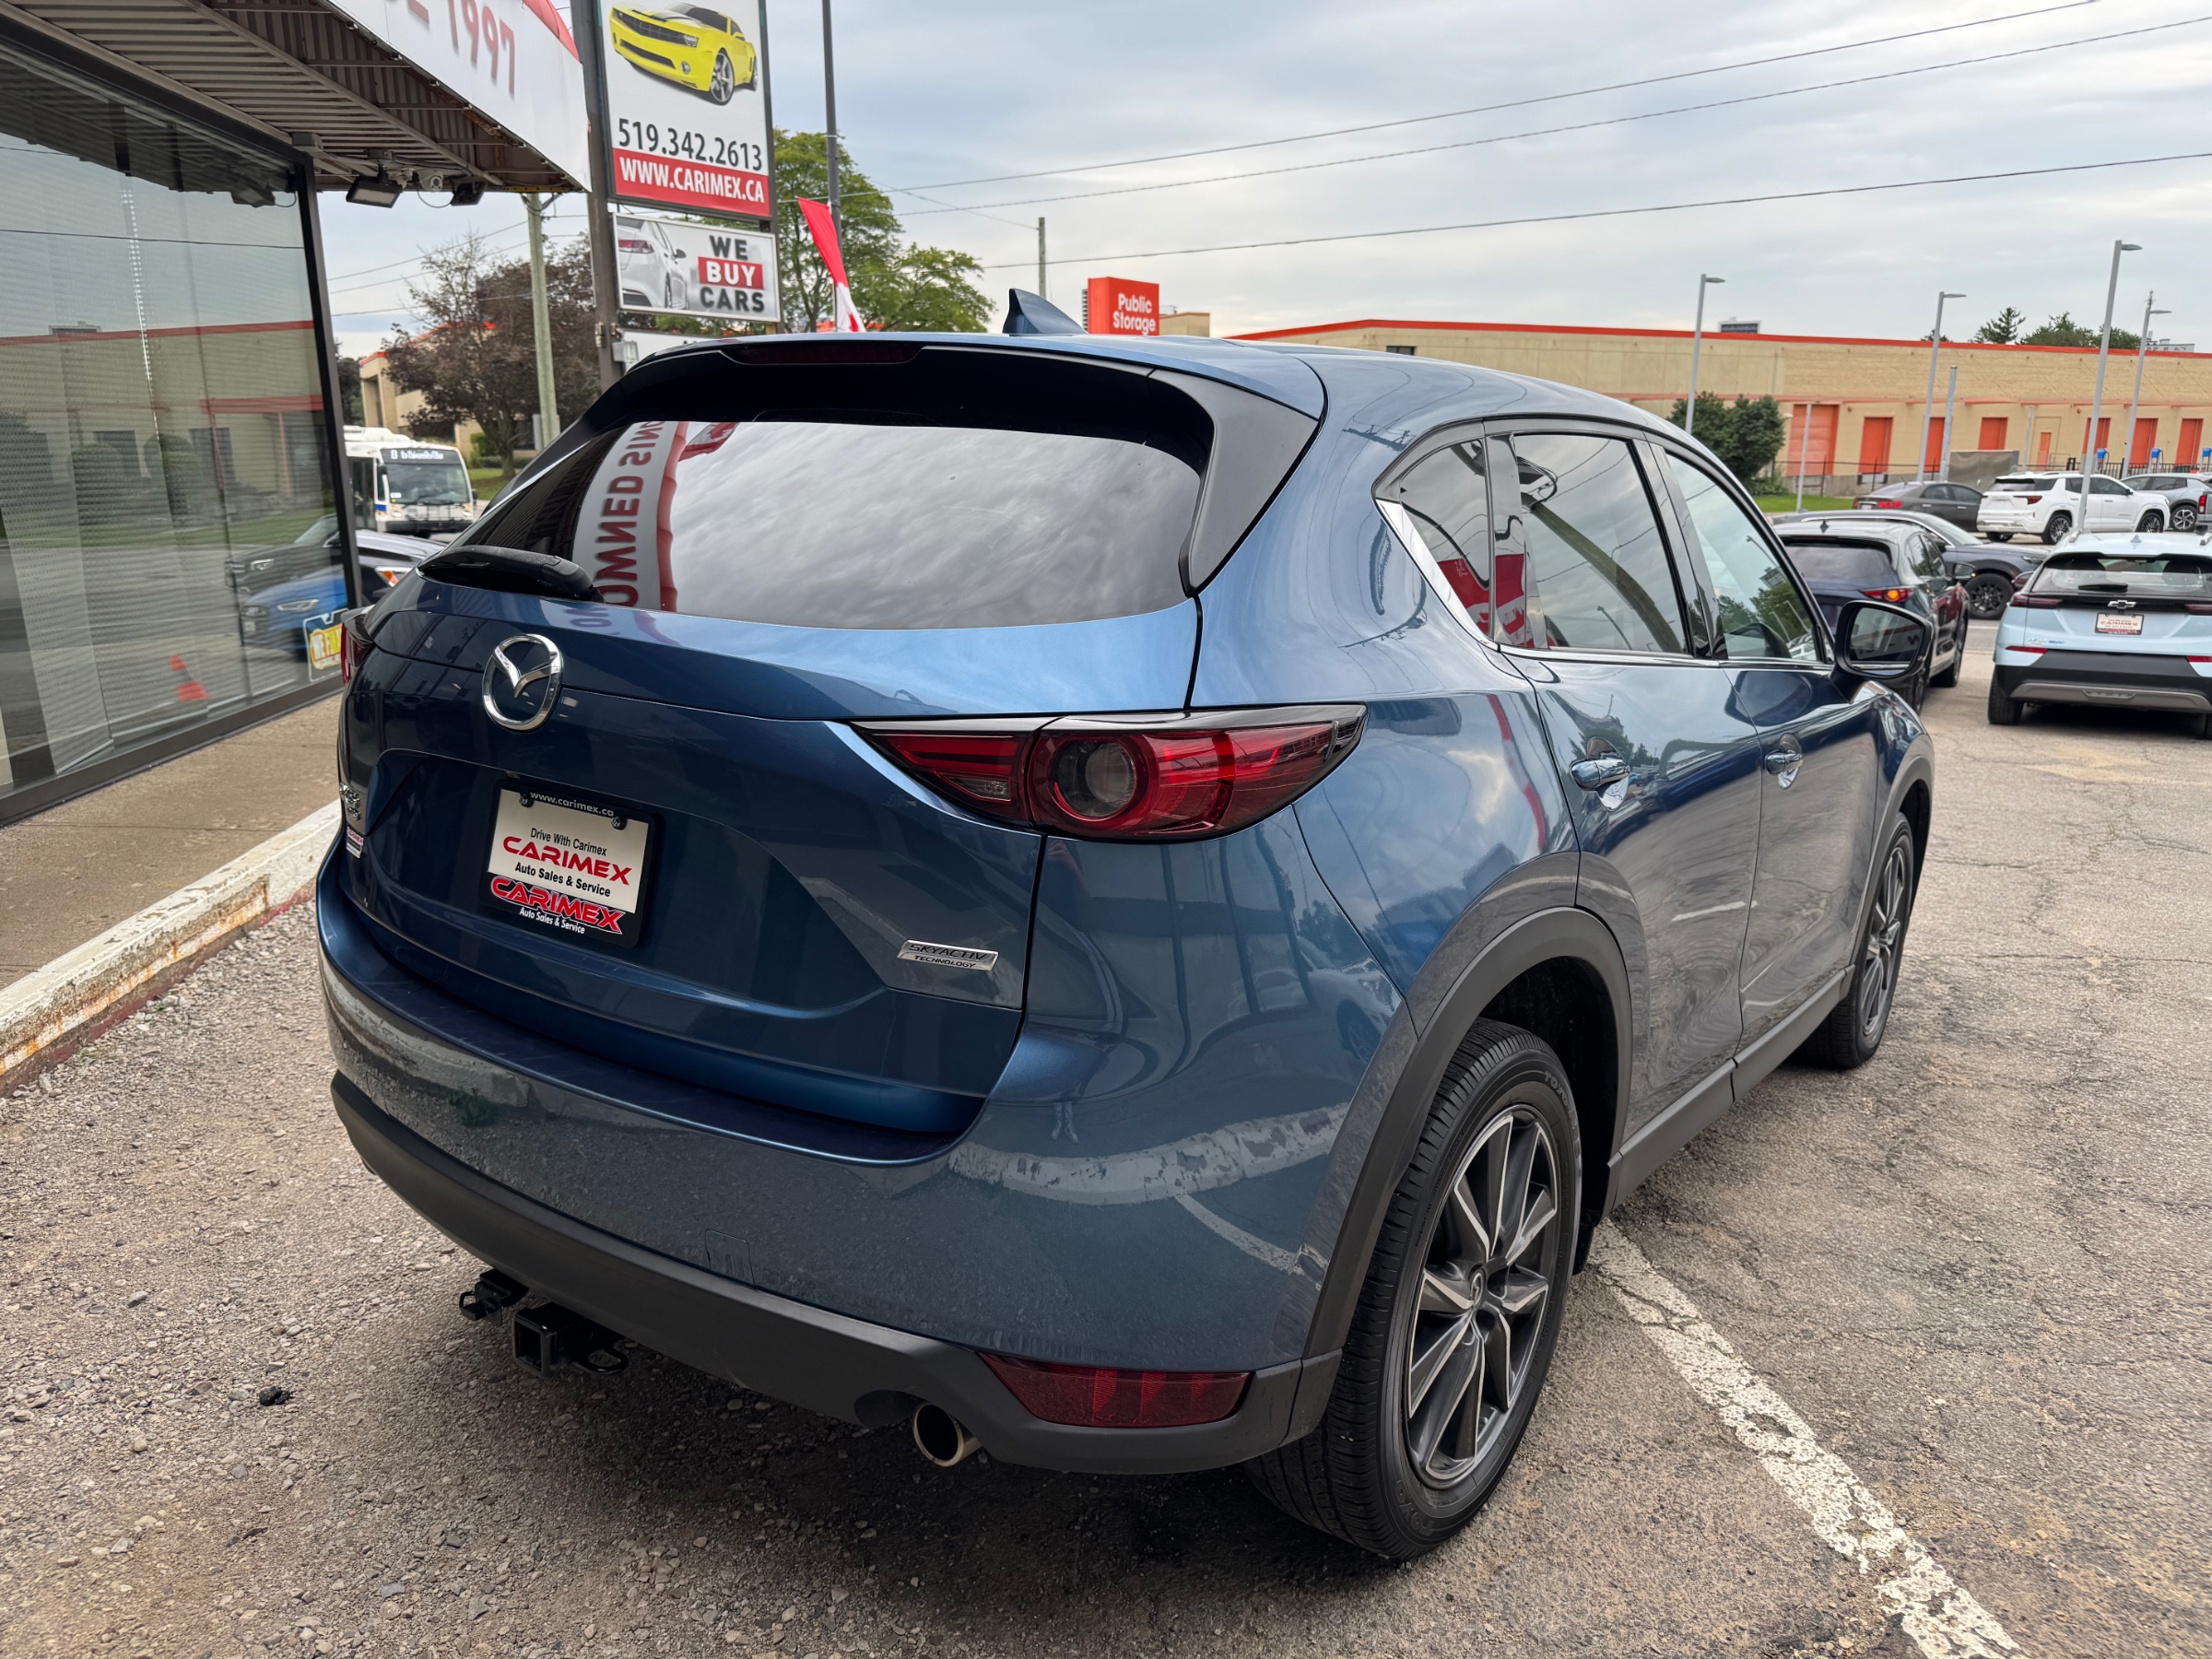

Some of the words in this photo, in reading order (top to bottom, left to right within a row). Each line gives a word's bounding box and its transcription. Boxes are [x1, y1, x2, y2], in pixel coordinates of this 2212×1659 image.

[448, 0, 516, 99] 1997
[618, 117, 763, 171] 519.342.2613
[618, 156, 765, 204] WWW.CARIMEX.CA
[709, 235, 748, 261] WE
[705, 260, 756, 287] BUY
[700, 286, 765, 312] CARS
[1117, 292, 1153, 314] Public
[1112, 311, 1157, 336] Storage
[530, 791, 615, 817] www.carimex.ca
[530, 827, 552, 842] Drive
[553, 832, 571, 848] With
[572, 838, 607, 857] Carimex
[502, 835, 632, 887] CARIMEX
[514, 861, 536, 877] Auto
[538, 867, 564, 885] Sales
[565, 876, 573, 887] &
[575, 877, 611, 898] Service
[490, 876, 627, 935] CARIMEX
[519, 906, 535, 920] Auto
[535, 912, 554, 925] Sales
[554, 917, 559, 926] &
[560, 919, 586, 935] Service
[909, 943, 988, 960] SKYACTIV
[913, 955, 977, 969] TECHNOLOGY
[1544, 1070, 1569, 1107] TOYO
